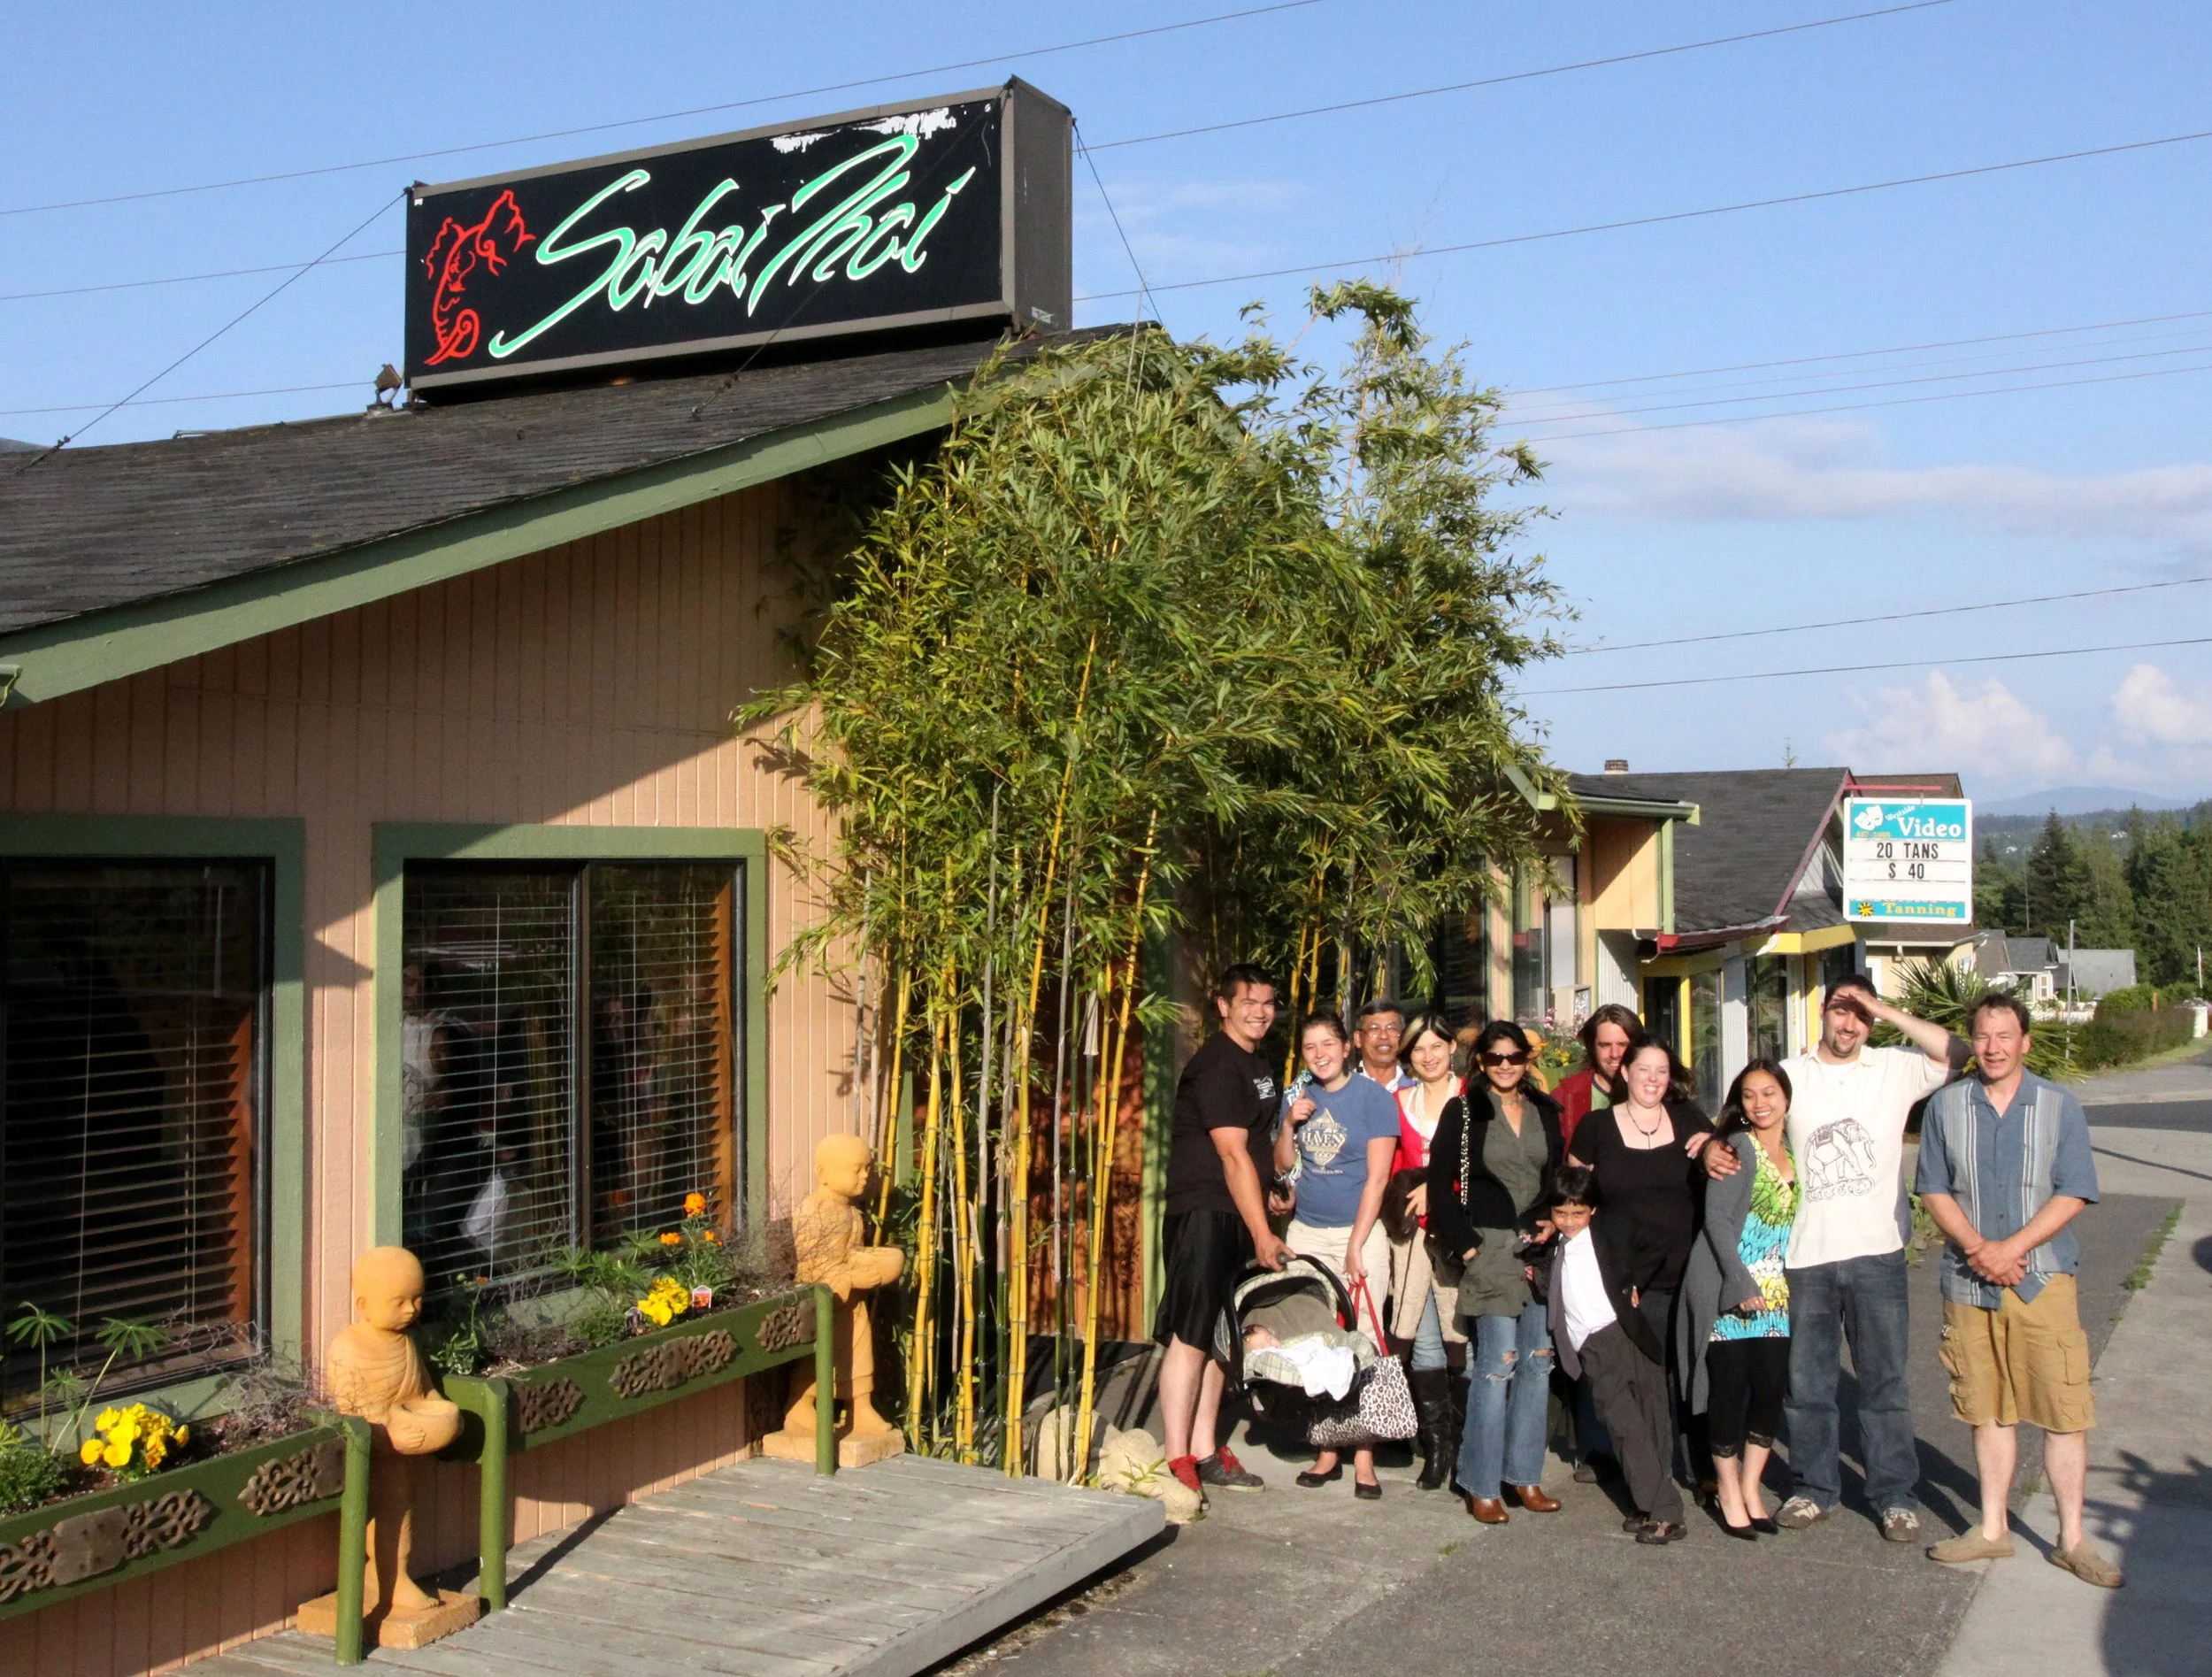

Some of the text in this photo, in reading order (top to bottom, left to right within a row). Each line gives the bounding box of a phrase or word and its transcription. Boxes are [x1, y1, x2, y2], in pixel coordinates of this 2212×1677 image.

[488, 134, 975, 358] Sabai Thai
[1897, 817, 1962, 837] Video
[1877, 842, 1939, 859] 20 TANS
[1908, 863, 1924, 879] 40
[1885, 902, 1956, 918] Tanning
[1302, 1130, 1345, 1144] HAVEN
